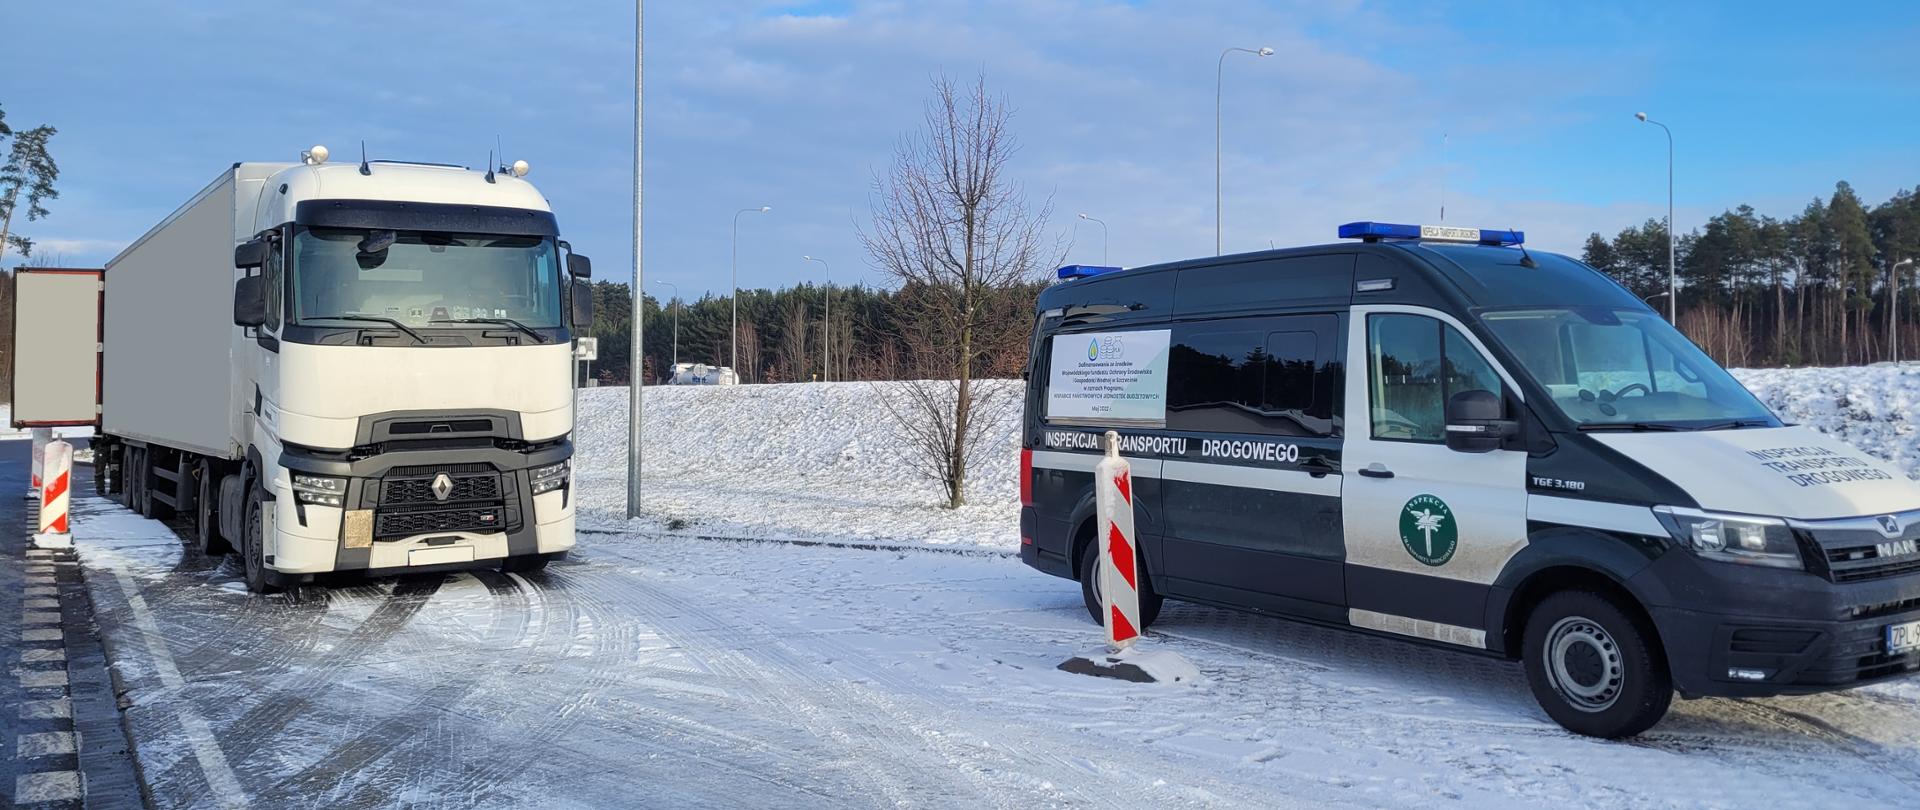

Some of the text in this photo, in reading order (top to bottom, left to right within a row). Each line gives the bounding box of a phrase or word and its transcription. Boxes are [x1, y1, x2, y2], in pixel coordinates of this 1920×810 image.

[1045, 431, 1299, 463] INSPEKCJA RANSPORTU DROGOWEGO
[1745, 446, 1838, 461] INSPEKCJA
[1762, 456, 1868, 473] TRANSPORTU
[1532, 476, 1585, 490] TGE 3.180
[1786, 468, 1893, 488] DROGOWEGO
[1406, 496, 1448, 515] INSPEKCJA
[1876, 539, 1918, 558] MAN
[1892, 625, 1912, 647] ZPL
